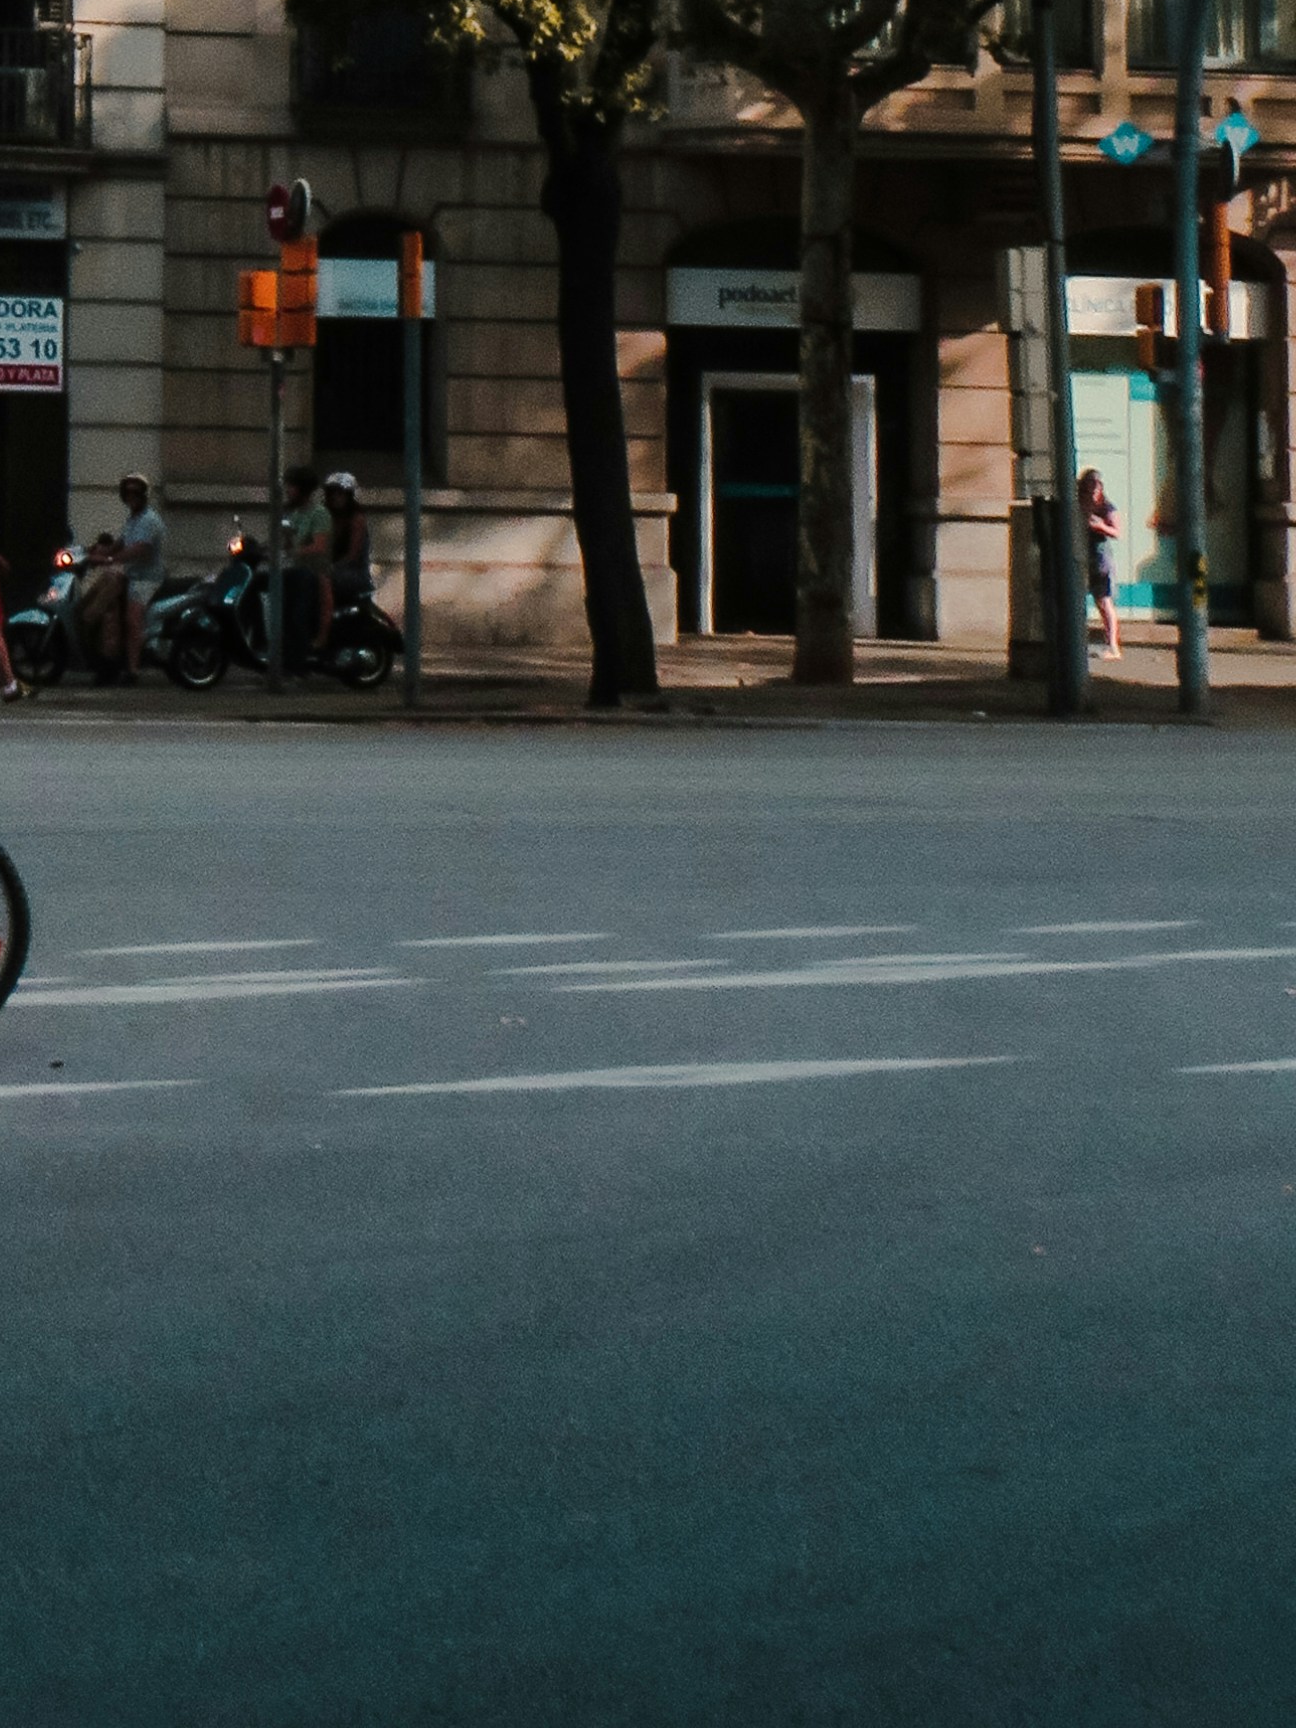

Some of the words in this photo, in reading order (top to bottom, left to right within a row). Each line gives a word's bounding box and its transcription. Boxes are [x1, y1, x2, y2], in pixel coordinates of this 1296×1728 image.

[31, 339, 58, 360] 10
[7, 367, 15, 380] Y
[17, 367, 57, 382] PLATA
